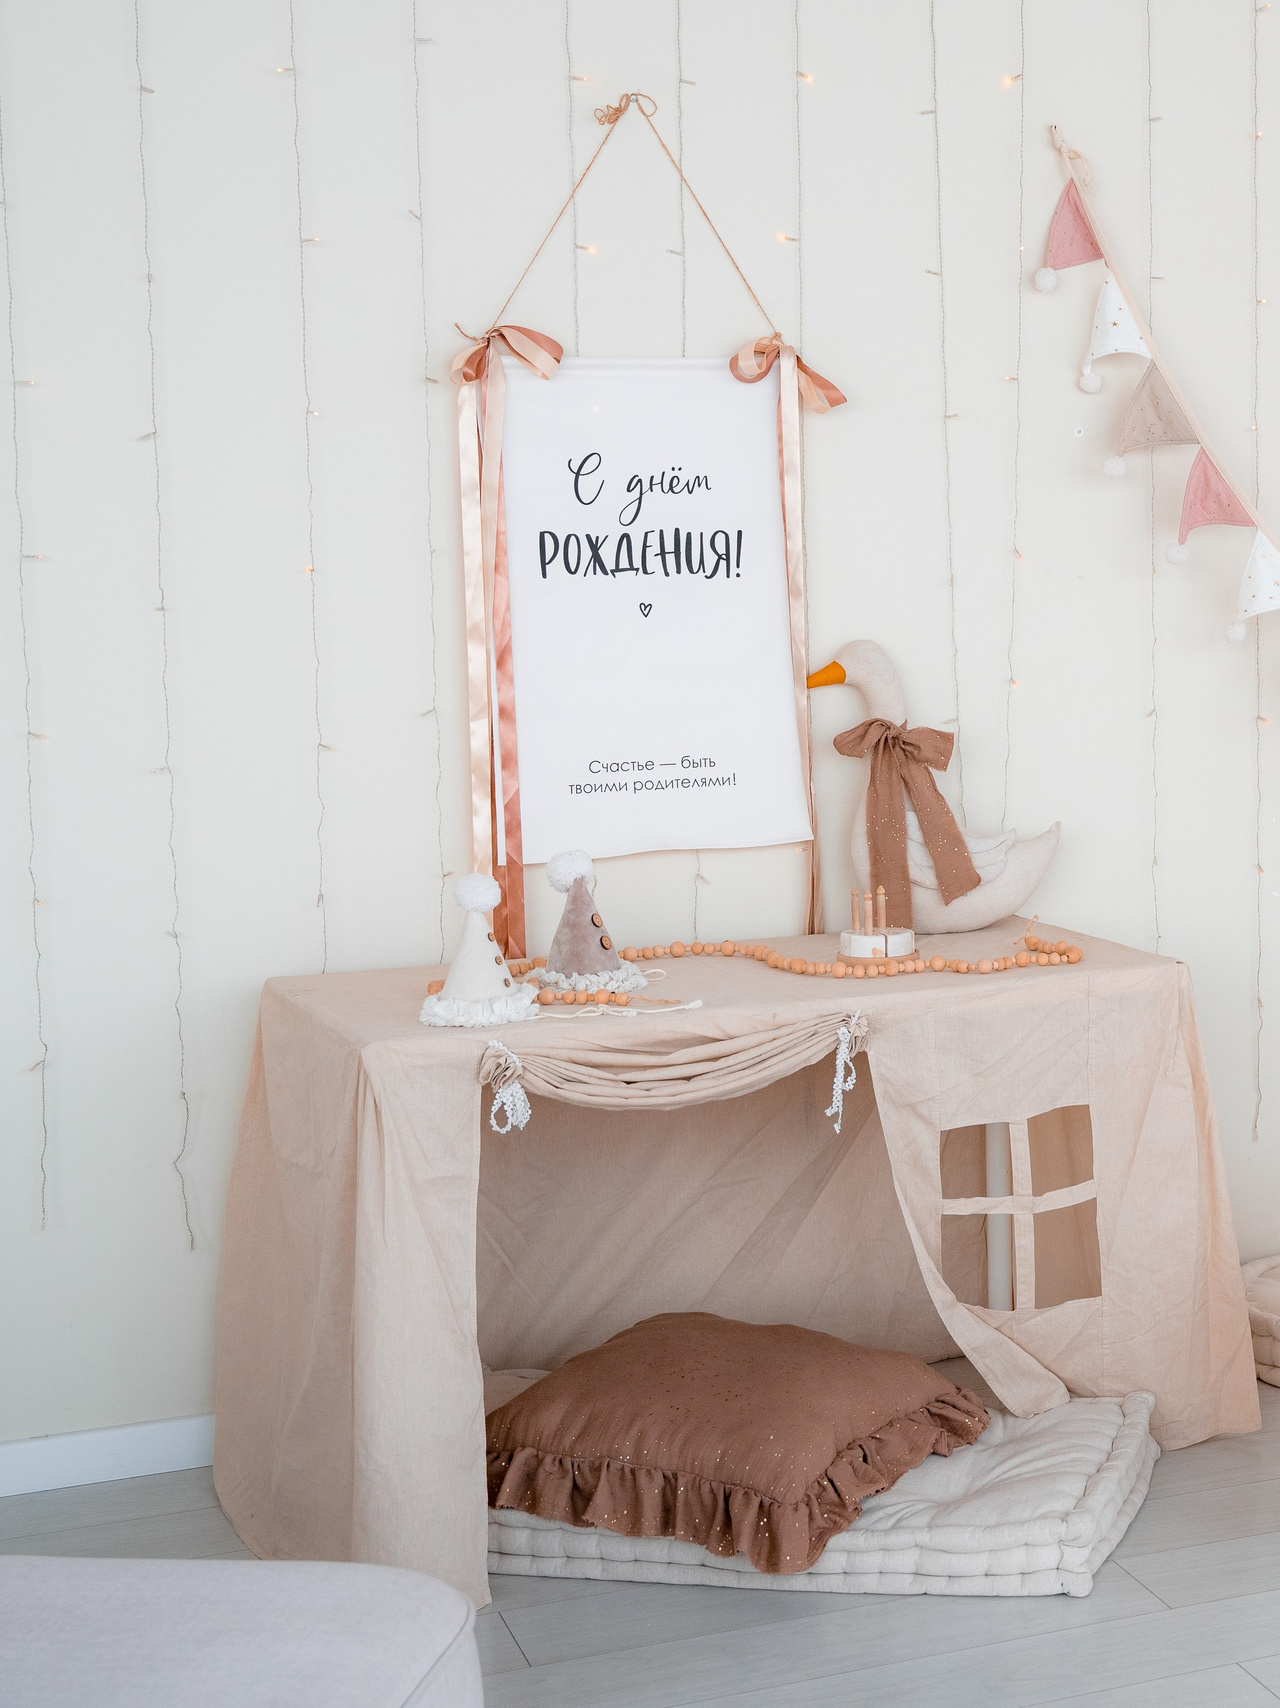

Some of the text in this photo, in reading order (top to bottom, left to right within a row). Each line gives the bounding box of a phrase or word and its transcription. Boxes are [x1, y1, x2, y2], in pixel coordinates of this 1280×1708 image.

[567, 452, 712, 527] С днём
[538, 527, 743, 580] РОЖДЕНИЯ!
[568, 772, 737, 795] твоими родителями!
[588, 759, 655, 774] Счастье
[680, 755, 716, 769] быть
